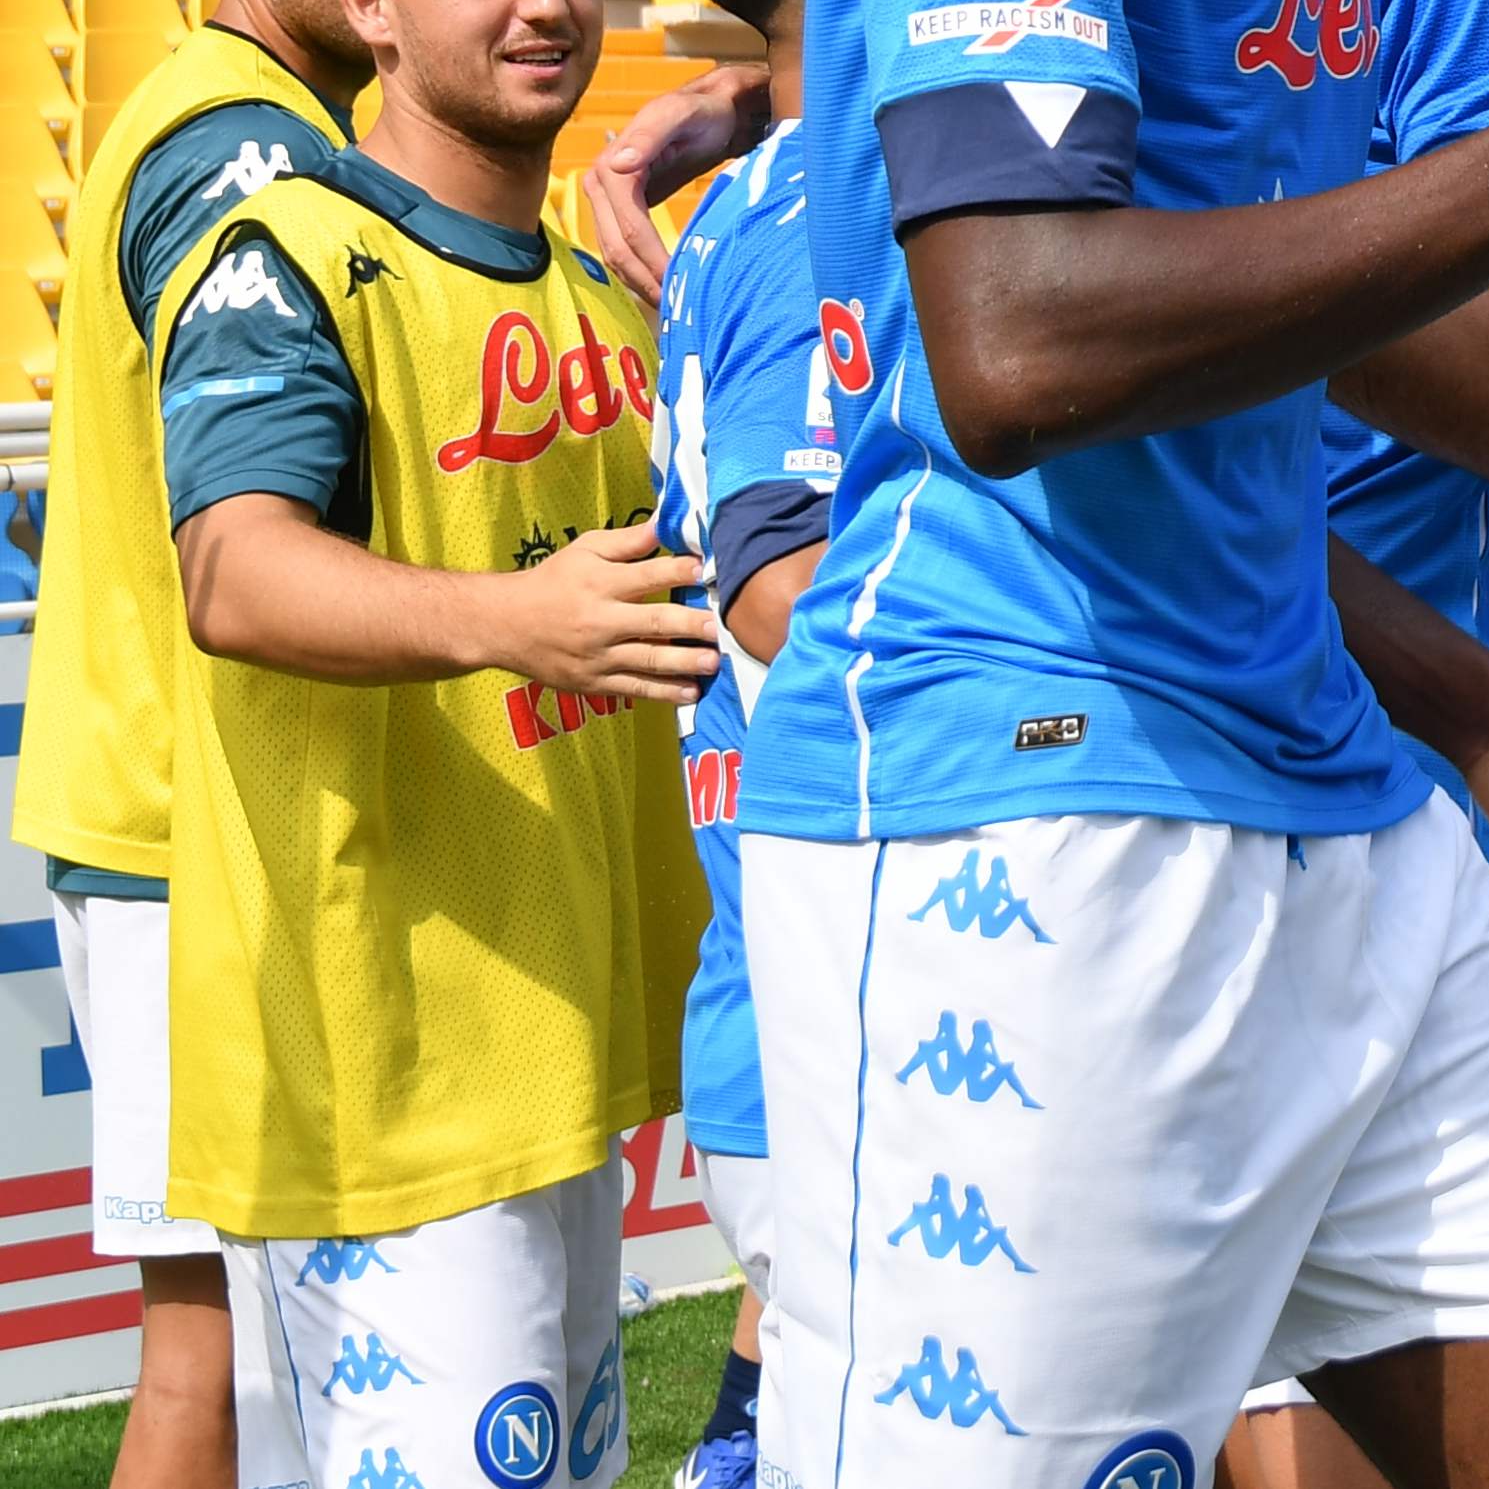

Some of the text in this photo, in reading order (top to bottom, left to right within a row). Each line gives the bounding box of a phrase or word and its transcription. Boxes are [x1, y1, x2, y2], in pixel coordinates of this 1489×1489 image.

[914, 7, 1104, 43] KEEP RACISM OUT
[437, 308, 655, 475] Lete
[789, 452, 836, 468] KEEP
[502, 1410, 542, 1465] N
